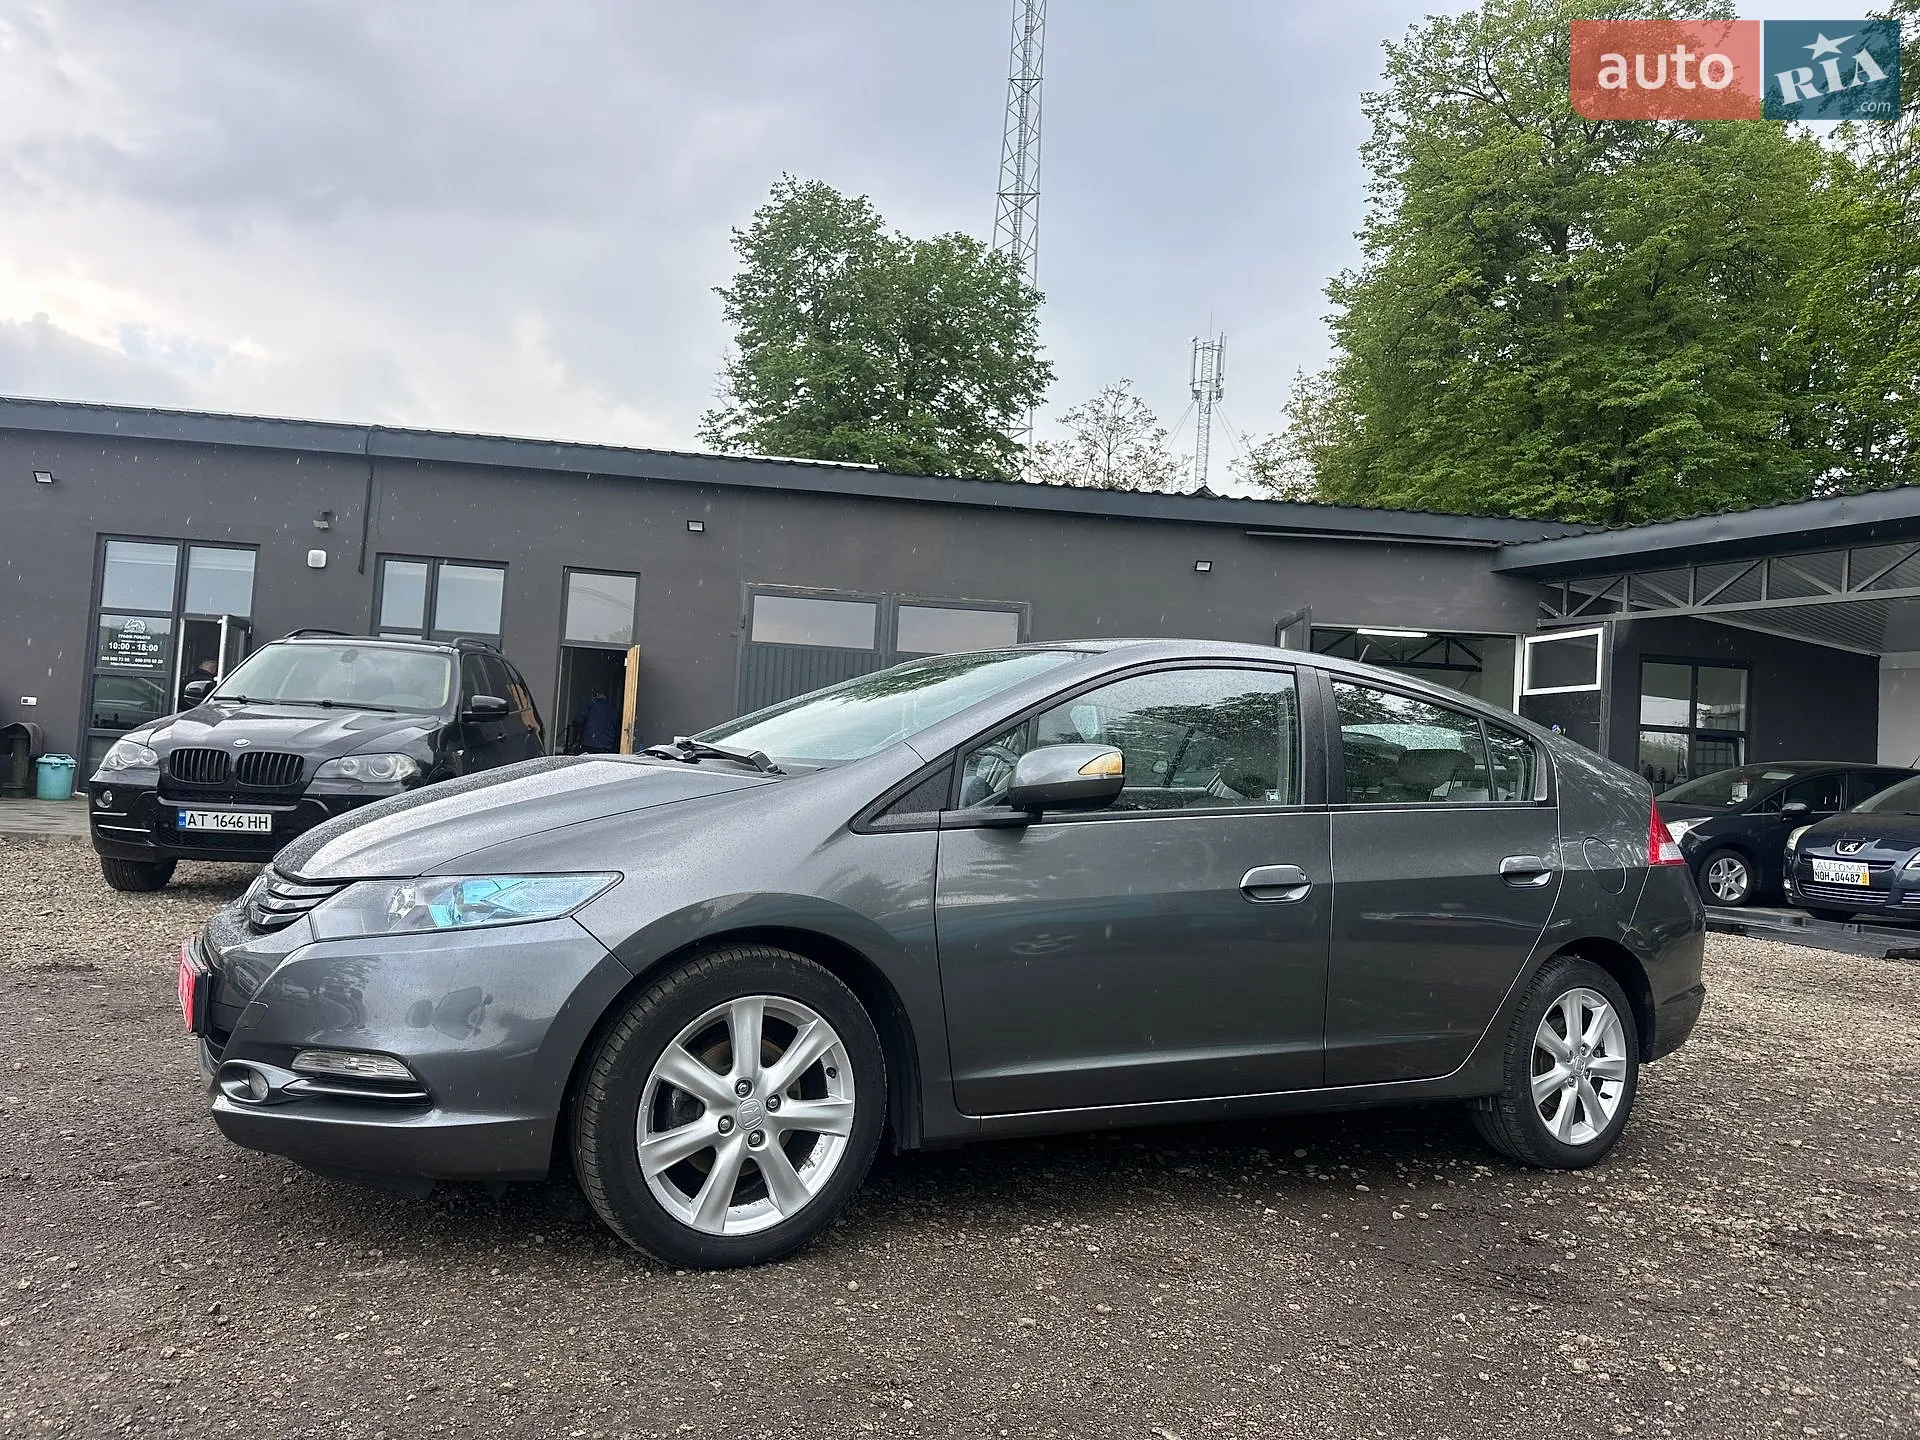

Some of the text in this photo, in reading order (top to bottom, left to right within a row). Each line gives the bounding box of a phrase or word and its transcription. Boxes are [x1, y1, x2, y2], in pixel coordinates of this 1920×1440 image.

[109, 642, 130, 650] 10:00
[137, 643, 158, 652] 18:00
[187, 813, 268, 829] AT 1646 HH
[1816, 861, 1867, 873] AUTOMAT
